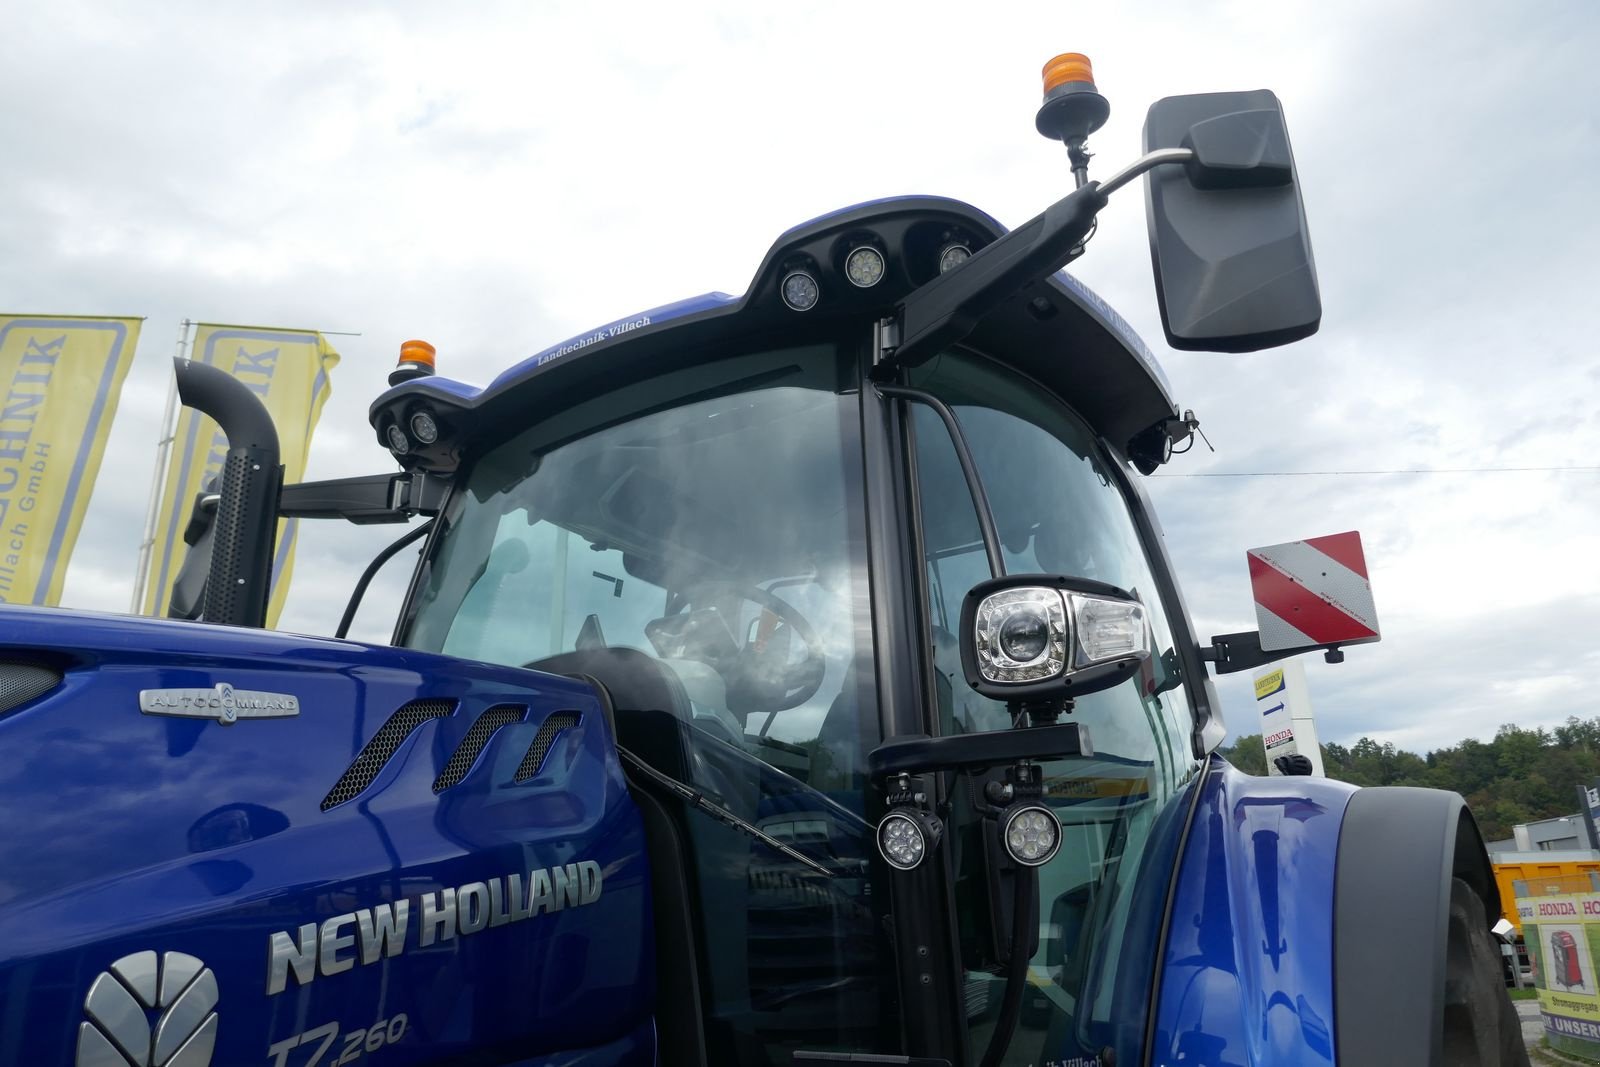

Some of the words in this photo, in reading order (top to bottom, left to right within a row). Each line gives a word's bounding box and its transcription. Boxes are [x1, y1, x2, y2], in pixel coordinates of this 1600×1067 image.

[537, 316, 651, 366] Landtechnik-Villach
[18, 442, 51, 513] GmbH
[150, 695, 298, 711] AUTOCOMMAND
[1265, 729, 1293, 744] HONDA
[1538, 902, 1577, 916] HONDA
[266, 898, 410, 996] NEW
[420, 859, 602, 948] HOLLAND
[1554, 1017, 1600, 1039] UNSER
